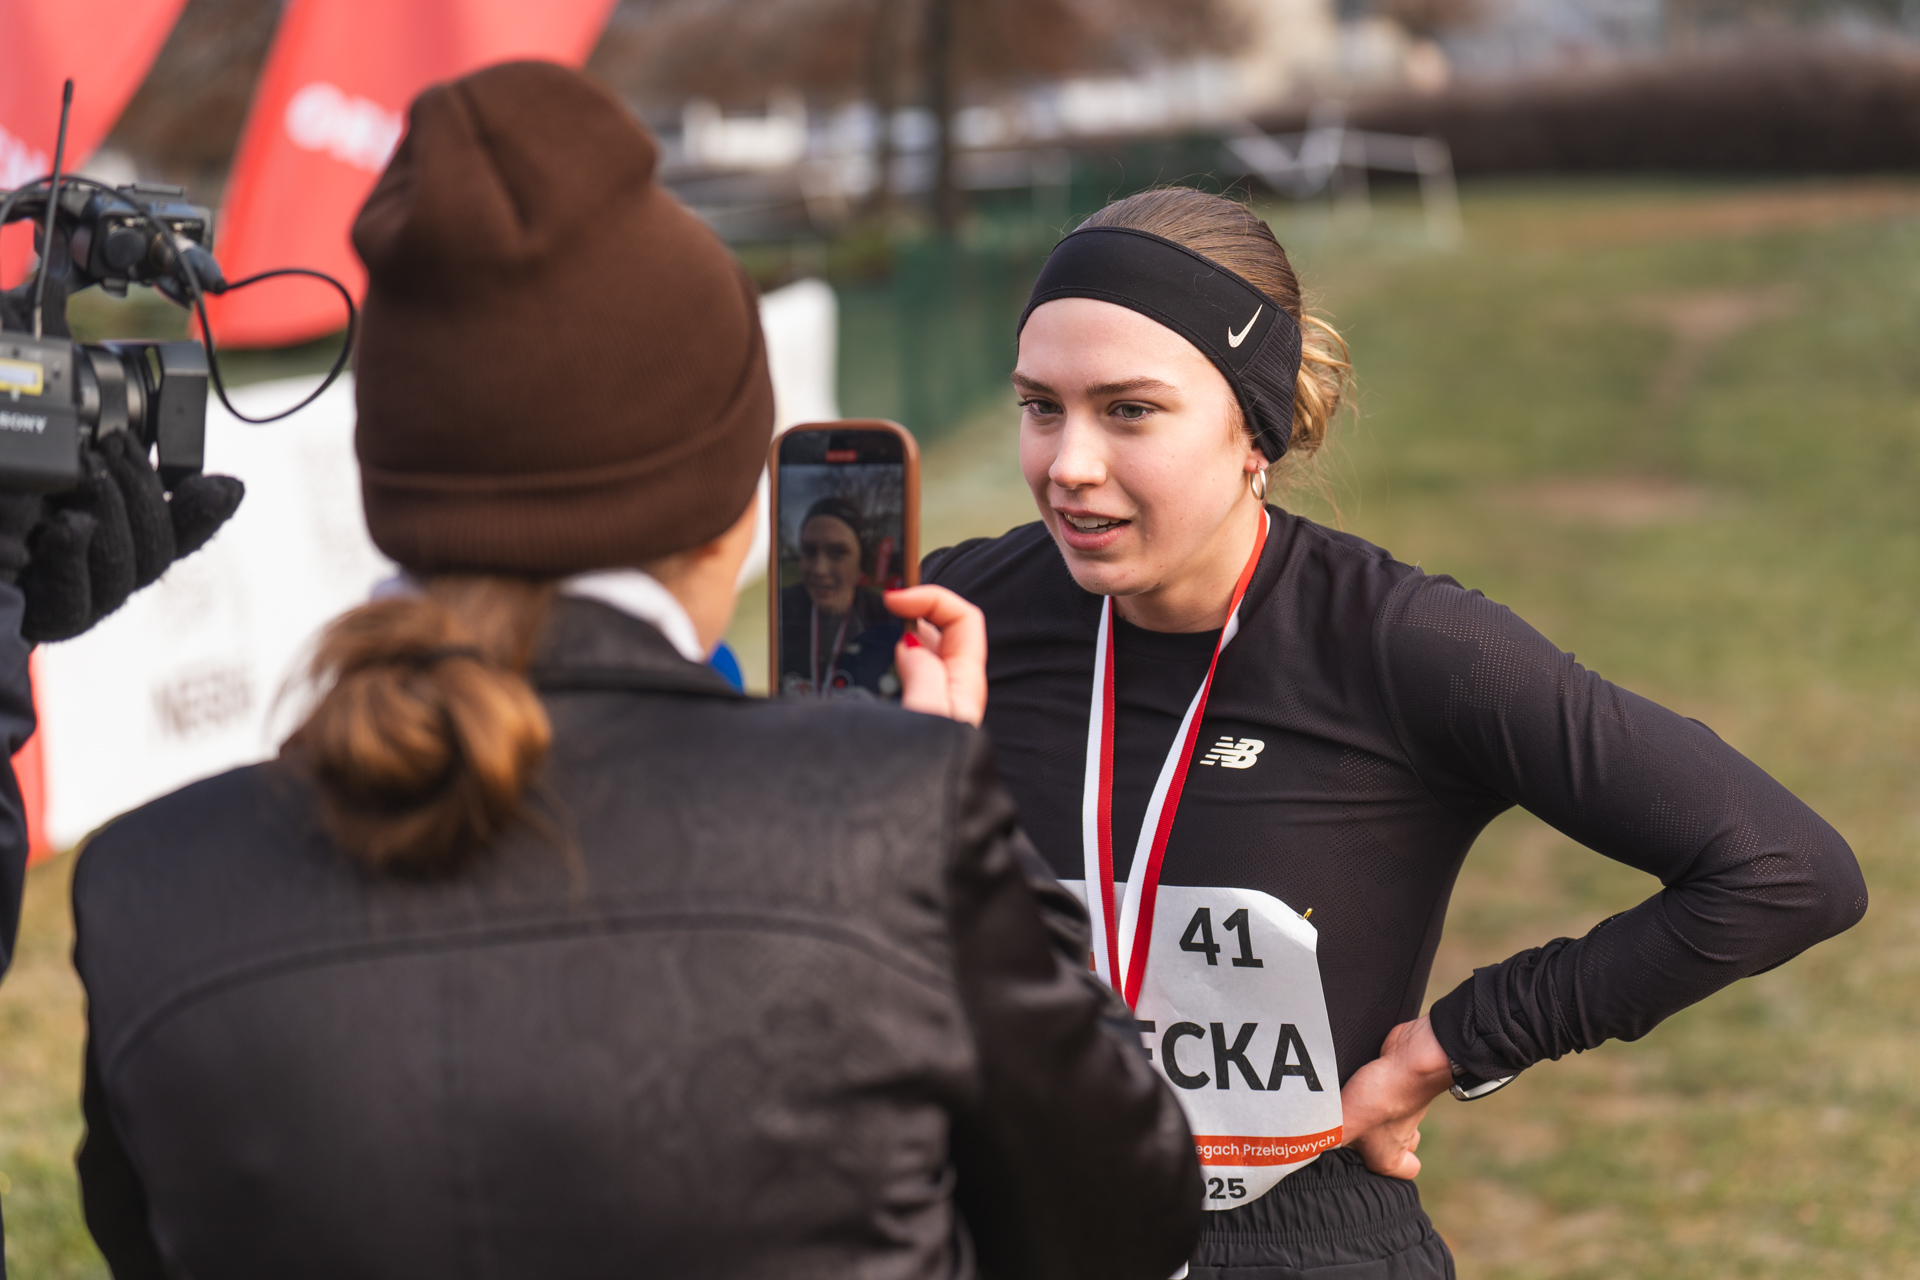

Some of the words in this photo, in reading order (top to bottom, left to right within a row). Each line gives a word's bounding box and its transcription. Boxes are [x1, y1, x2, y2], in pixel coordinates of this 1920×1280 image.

[1179, 907, 1264, 968] 41
[1243, 1135, 1336, 1158] Przełajowych
[1200, 1177, 1247, 1200] 25
